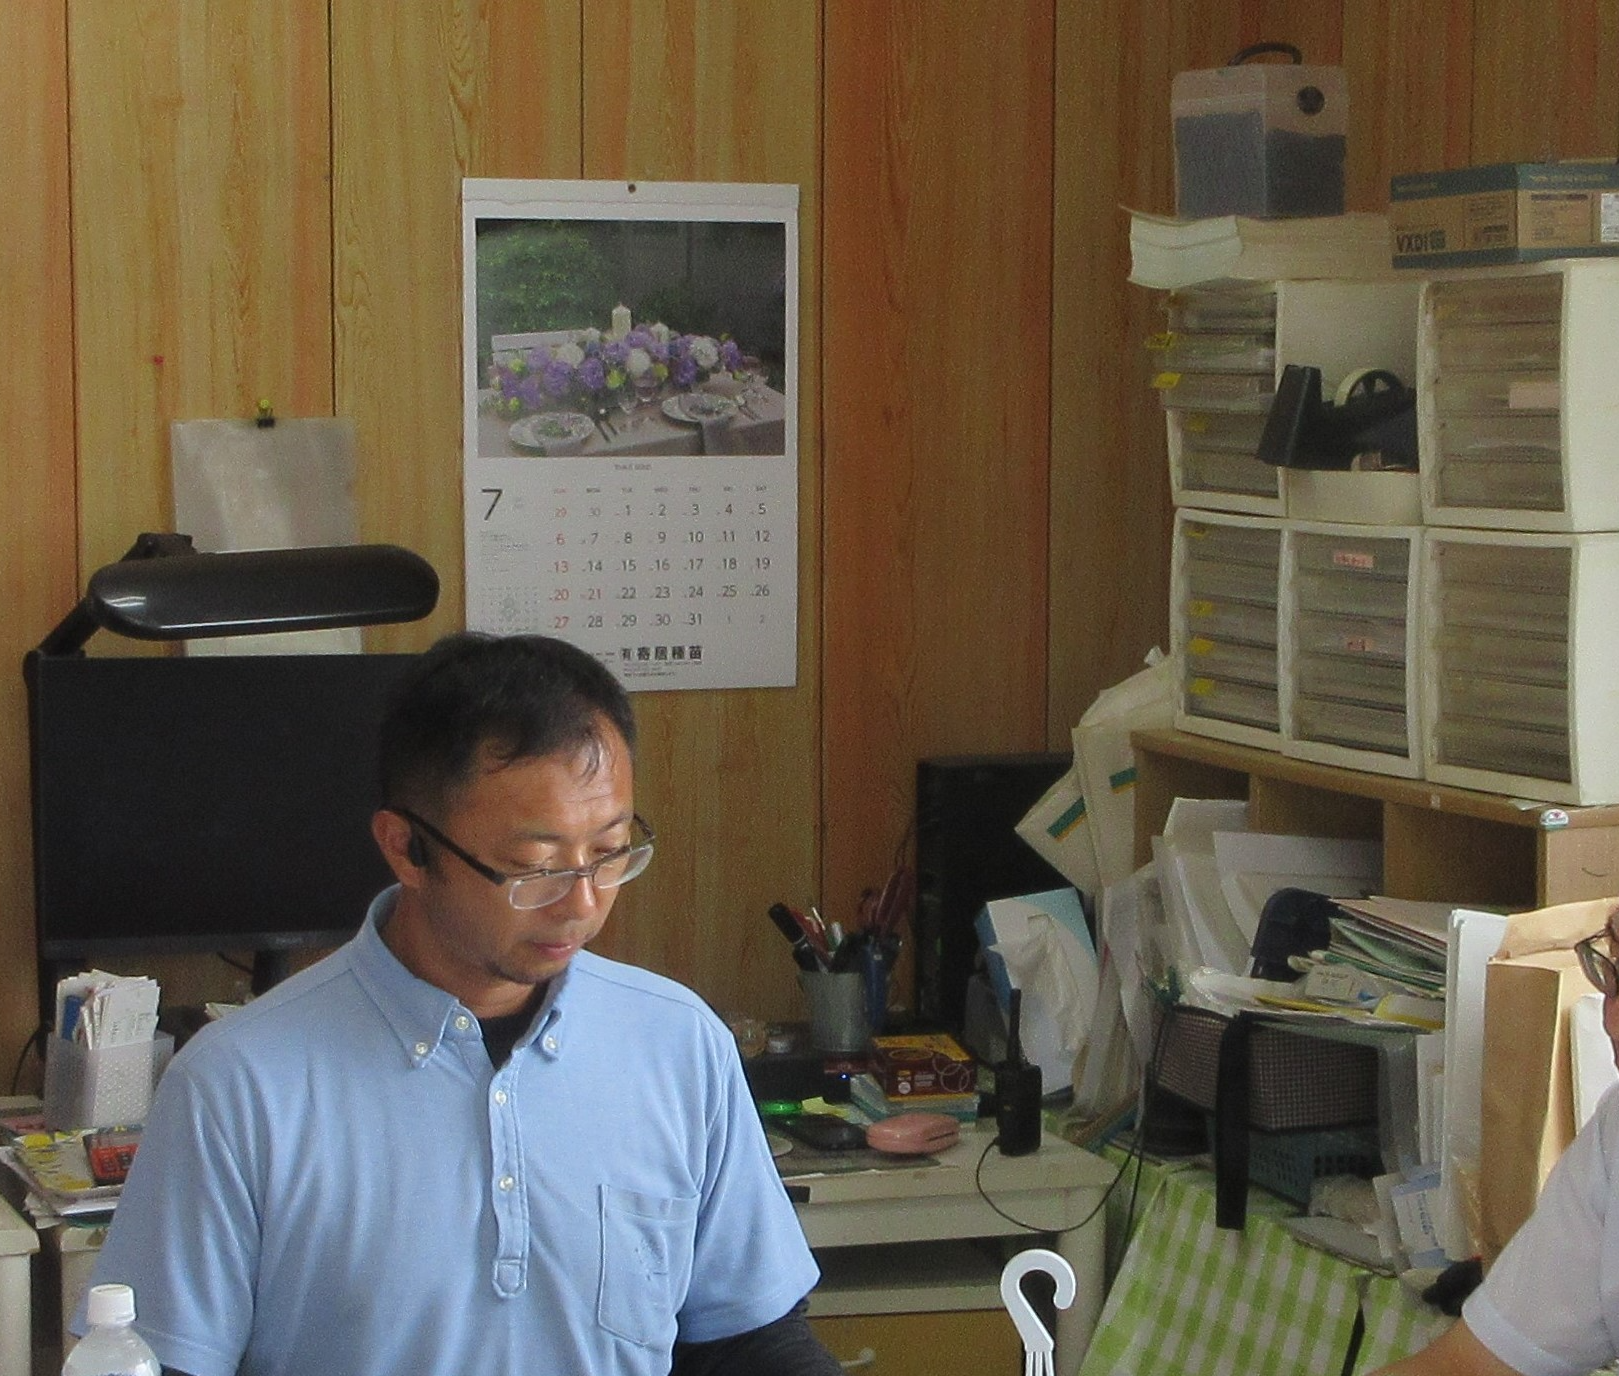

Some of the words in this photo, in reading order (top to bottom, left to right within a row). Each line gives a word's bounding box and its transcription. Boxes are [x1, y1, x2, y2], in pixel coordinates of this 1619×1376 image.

[481, 488, 503, 521] 7
[689, 531, 704, 543] 10
[722, 531, 735, 543] 11
[755, 530, 770, 542] 12
[554, 561, 569, 573] 13
[588, 560, 602, 572] 14
[622, 560, 636, 572] 15
[655, 559, 670, 571] 16
[689, 558, 703, 570] 17
[722, 558, 737, 570] 18
[756, 557, 770, 569] 19
[554, 589, 569, 600] 20
[588, 589, 601, 600] 21
[621, 588, 636, 599] 22
[655, 587, 670, 598] 23
[688, 586, 703, 598] 24
[722, 586, 737, 597] 25
[755, 585, 770, 596] 26
[554, 617, 569, 629] 27
[588, 616, 603, 628] 28
[621, 615, 637, 628] 29
[655, 615, 670, 627] 30
[689, 614, 703, 626] 31
